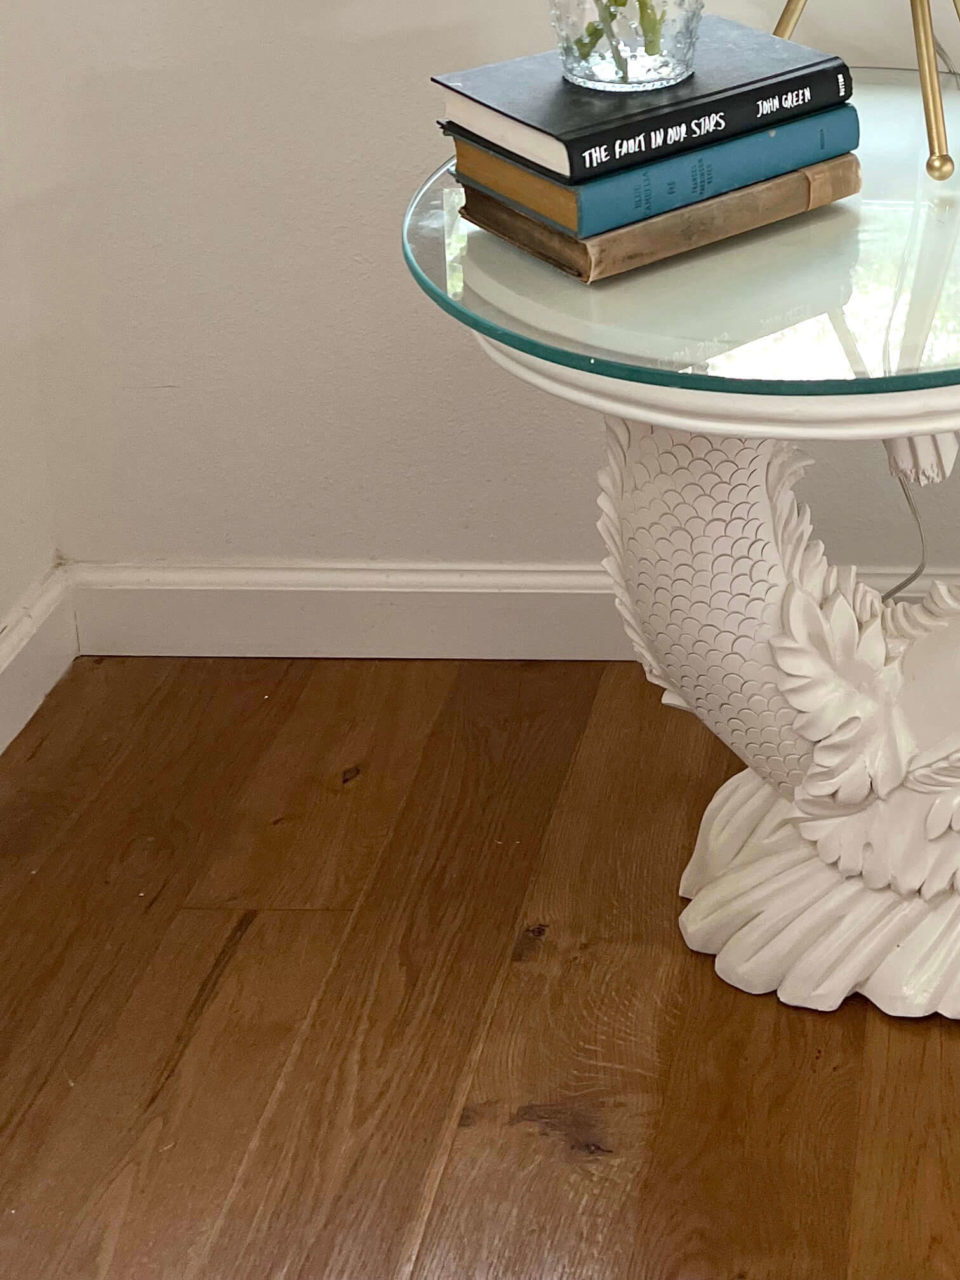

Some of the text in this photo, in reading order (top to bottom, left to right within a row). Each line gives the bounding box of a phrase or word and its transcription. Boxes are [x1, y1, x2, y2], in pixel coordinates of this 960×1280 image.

[756, 87, 811, 117] JOHN GREEN
[582, 113, 726, 169] THE FAULT IN OUR STARS
